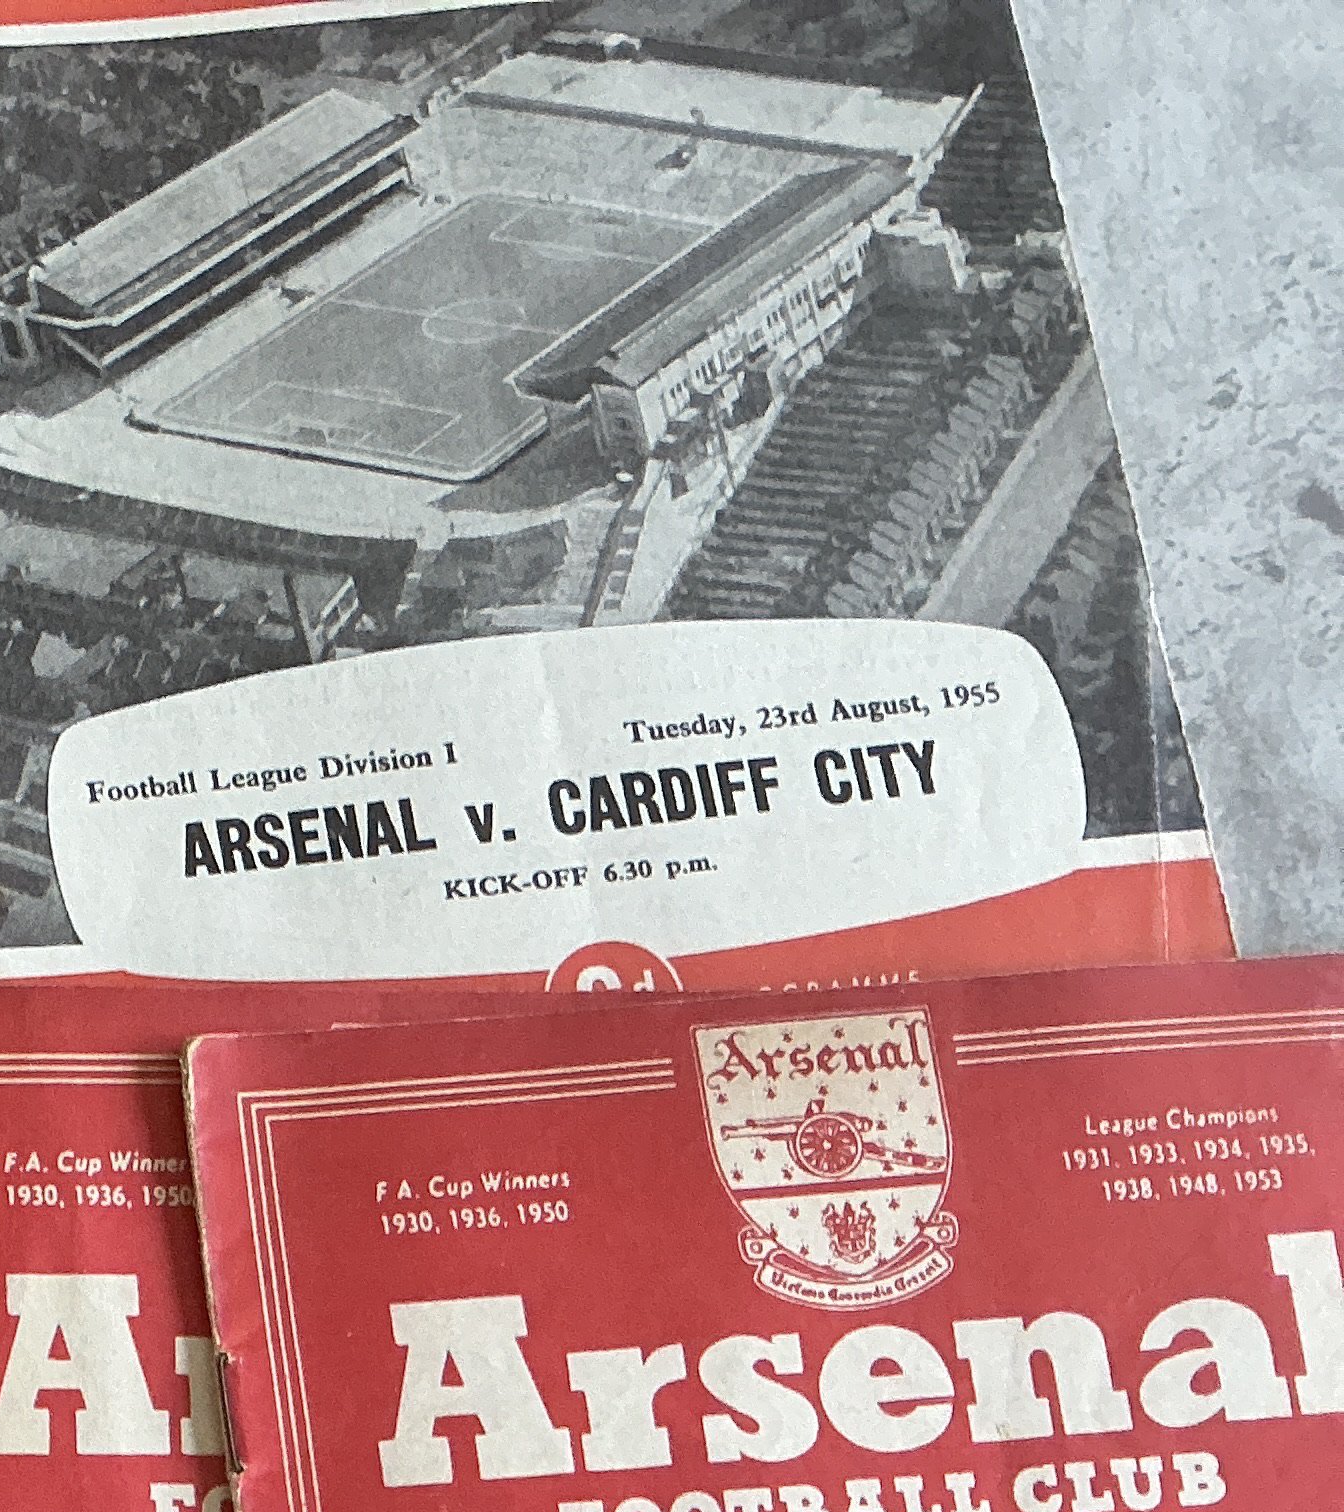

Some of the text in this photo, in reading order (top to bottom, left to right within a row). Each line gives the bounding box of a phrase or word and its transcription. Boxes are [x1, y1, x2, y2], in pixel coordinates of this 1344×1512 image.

[623, 680, 1001, 744] Tuesday, 23rd August, 1955
[86, 770, 198, 804] Football
[209, 766, 308, 793] League
[319, 746, 433, 780] Division
[183, 738, 937, 879] ARSENAL v. CARDIFF CITY
[443, 856, 719, 900] KICK-OFF 6.30 p.m.
[706, 1016, 929, 1091] Arsenal
[1084, 1106, 1280, 1137] League Champions
[4, 1151, 49, 1175] F.A.
[56, 1150, 102, 1176] Cup
[1128, 1141, 1187, 1165] 1933,
[1193, 1137, 1250, 1161] 1934,
[1259, 1132, 1316, 1157] 1935,
[6, 1184, 65, 1209] 1930,
[74, 1184, 133, 1209] 1936,
[428, 1175, 474, 1199] Cup
[480, 1170, 571, 1194] Winners
[1101, 1168, 1283, 1203] 1938, 1948, 1953
[380, 1200, 570, 1235] 1930, 1936, 1950
[376, 1230, 1344, 1488] Arsenal
